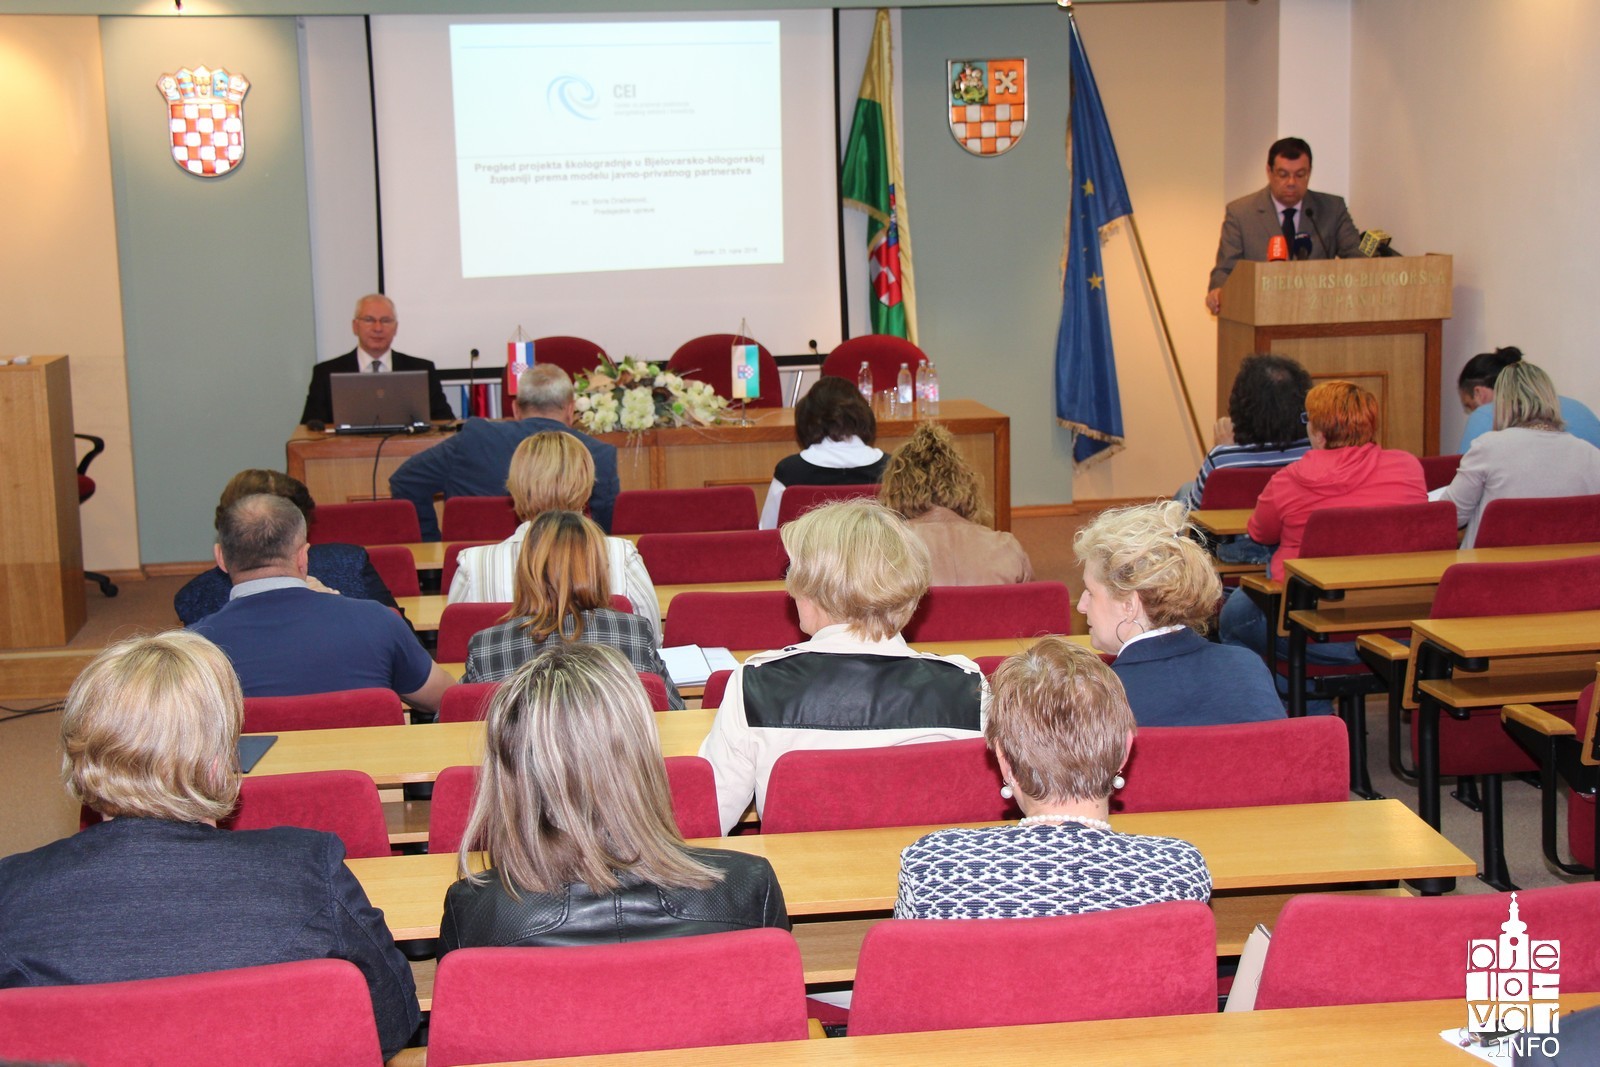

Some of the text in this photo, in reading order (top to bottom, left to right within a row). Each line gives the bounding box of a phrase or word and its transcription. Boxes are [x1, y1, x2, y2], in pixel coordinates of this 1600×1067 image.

[613, 84, 636, 99] CEI
[474, 162, 516, 173] Pregled
[519, 160, 562, 172] projekta
[565, 158, 632, 170] škologradnje
[644, 154, 765, 168] Bjelovarsko-bilogorskoj
[490, 167, 752, 185] županiji prema modelu javno-privatnog partnerstva
